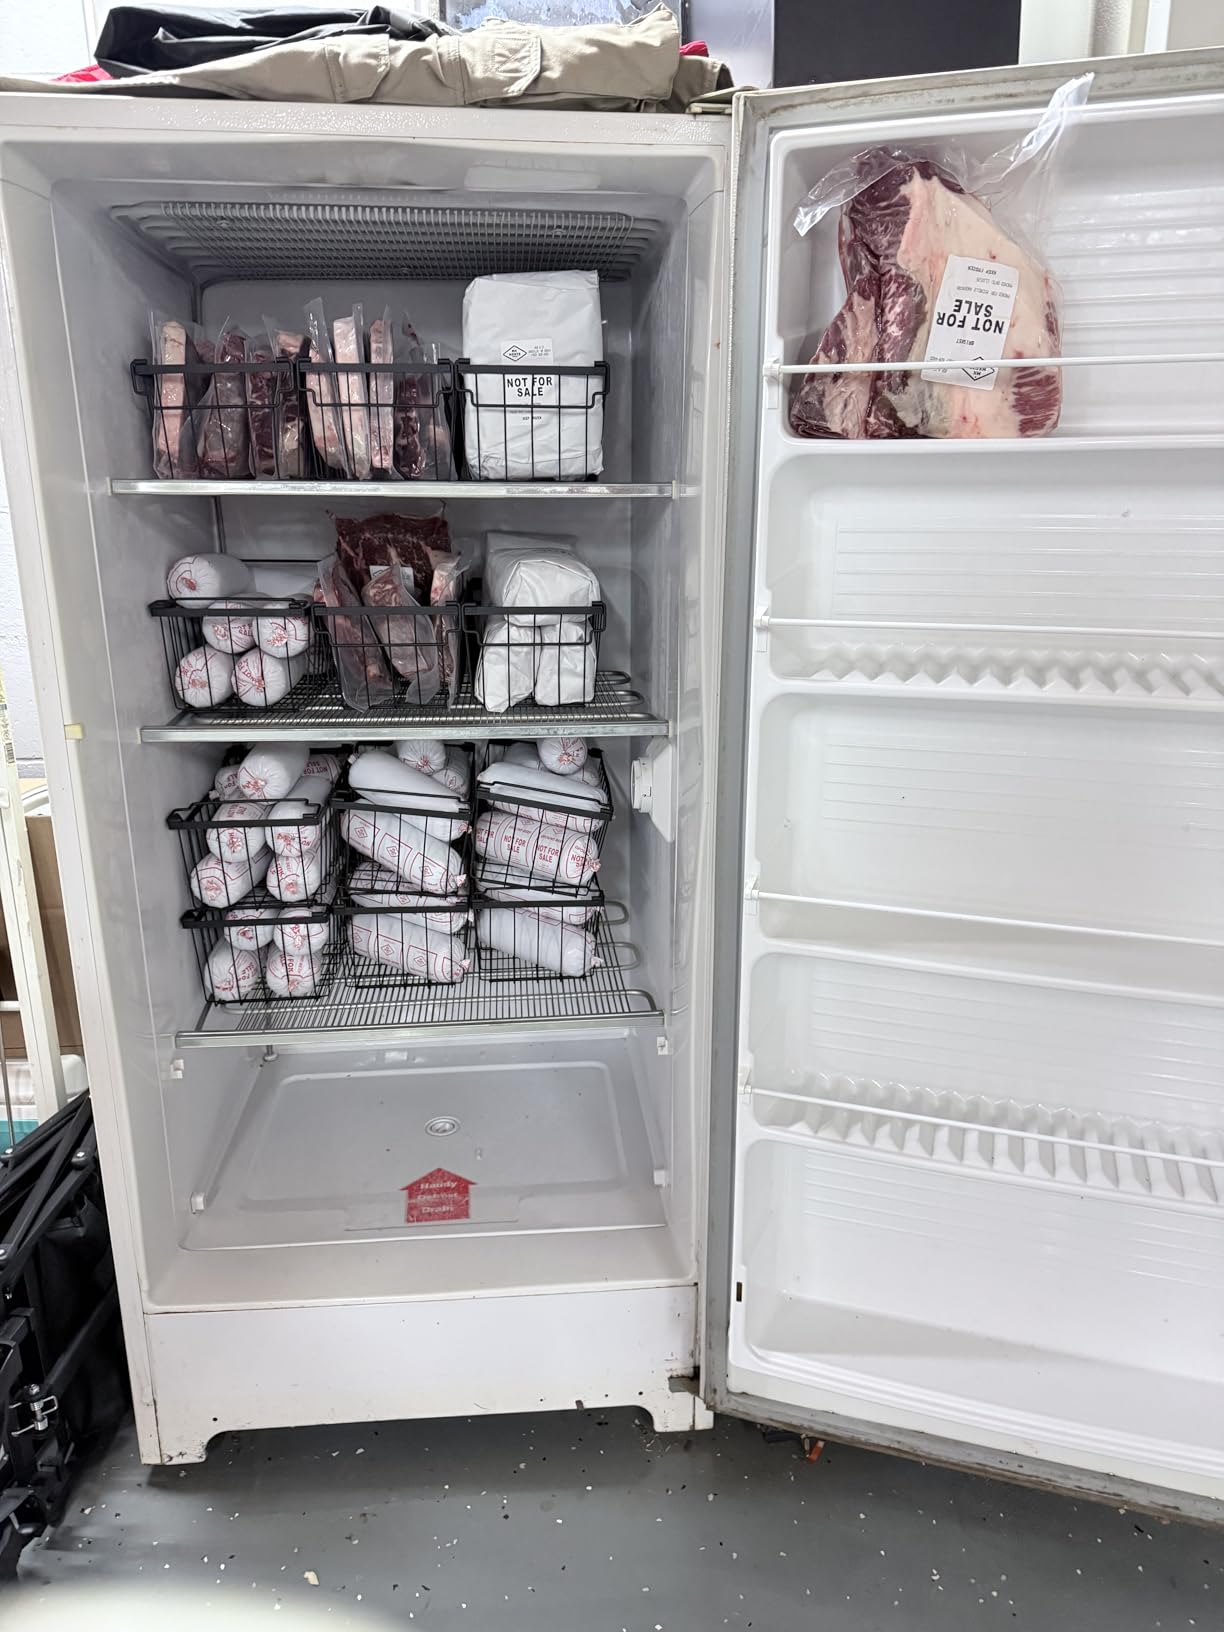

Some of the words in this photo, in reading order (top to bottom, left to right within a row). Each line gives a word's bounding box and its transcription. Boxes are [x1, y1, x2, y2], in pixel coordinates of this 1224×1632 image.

[953, 299, 994, 318] SALE
[936, 312, 967, 329] FOR
[971, 317, 1005, 334] NOT
[506, 377, 528, 388] NOT
[532, 376, 553, 386] FOR
[517, 387, 544, 397] SALE
[515, 837, 527, 847] FOR
[547, 847, 560, 857] FOR
[538, 853, 553, 864] SALE
[570, 854, 585, 864] NOT
